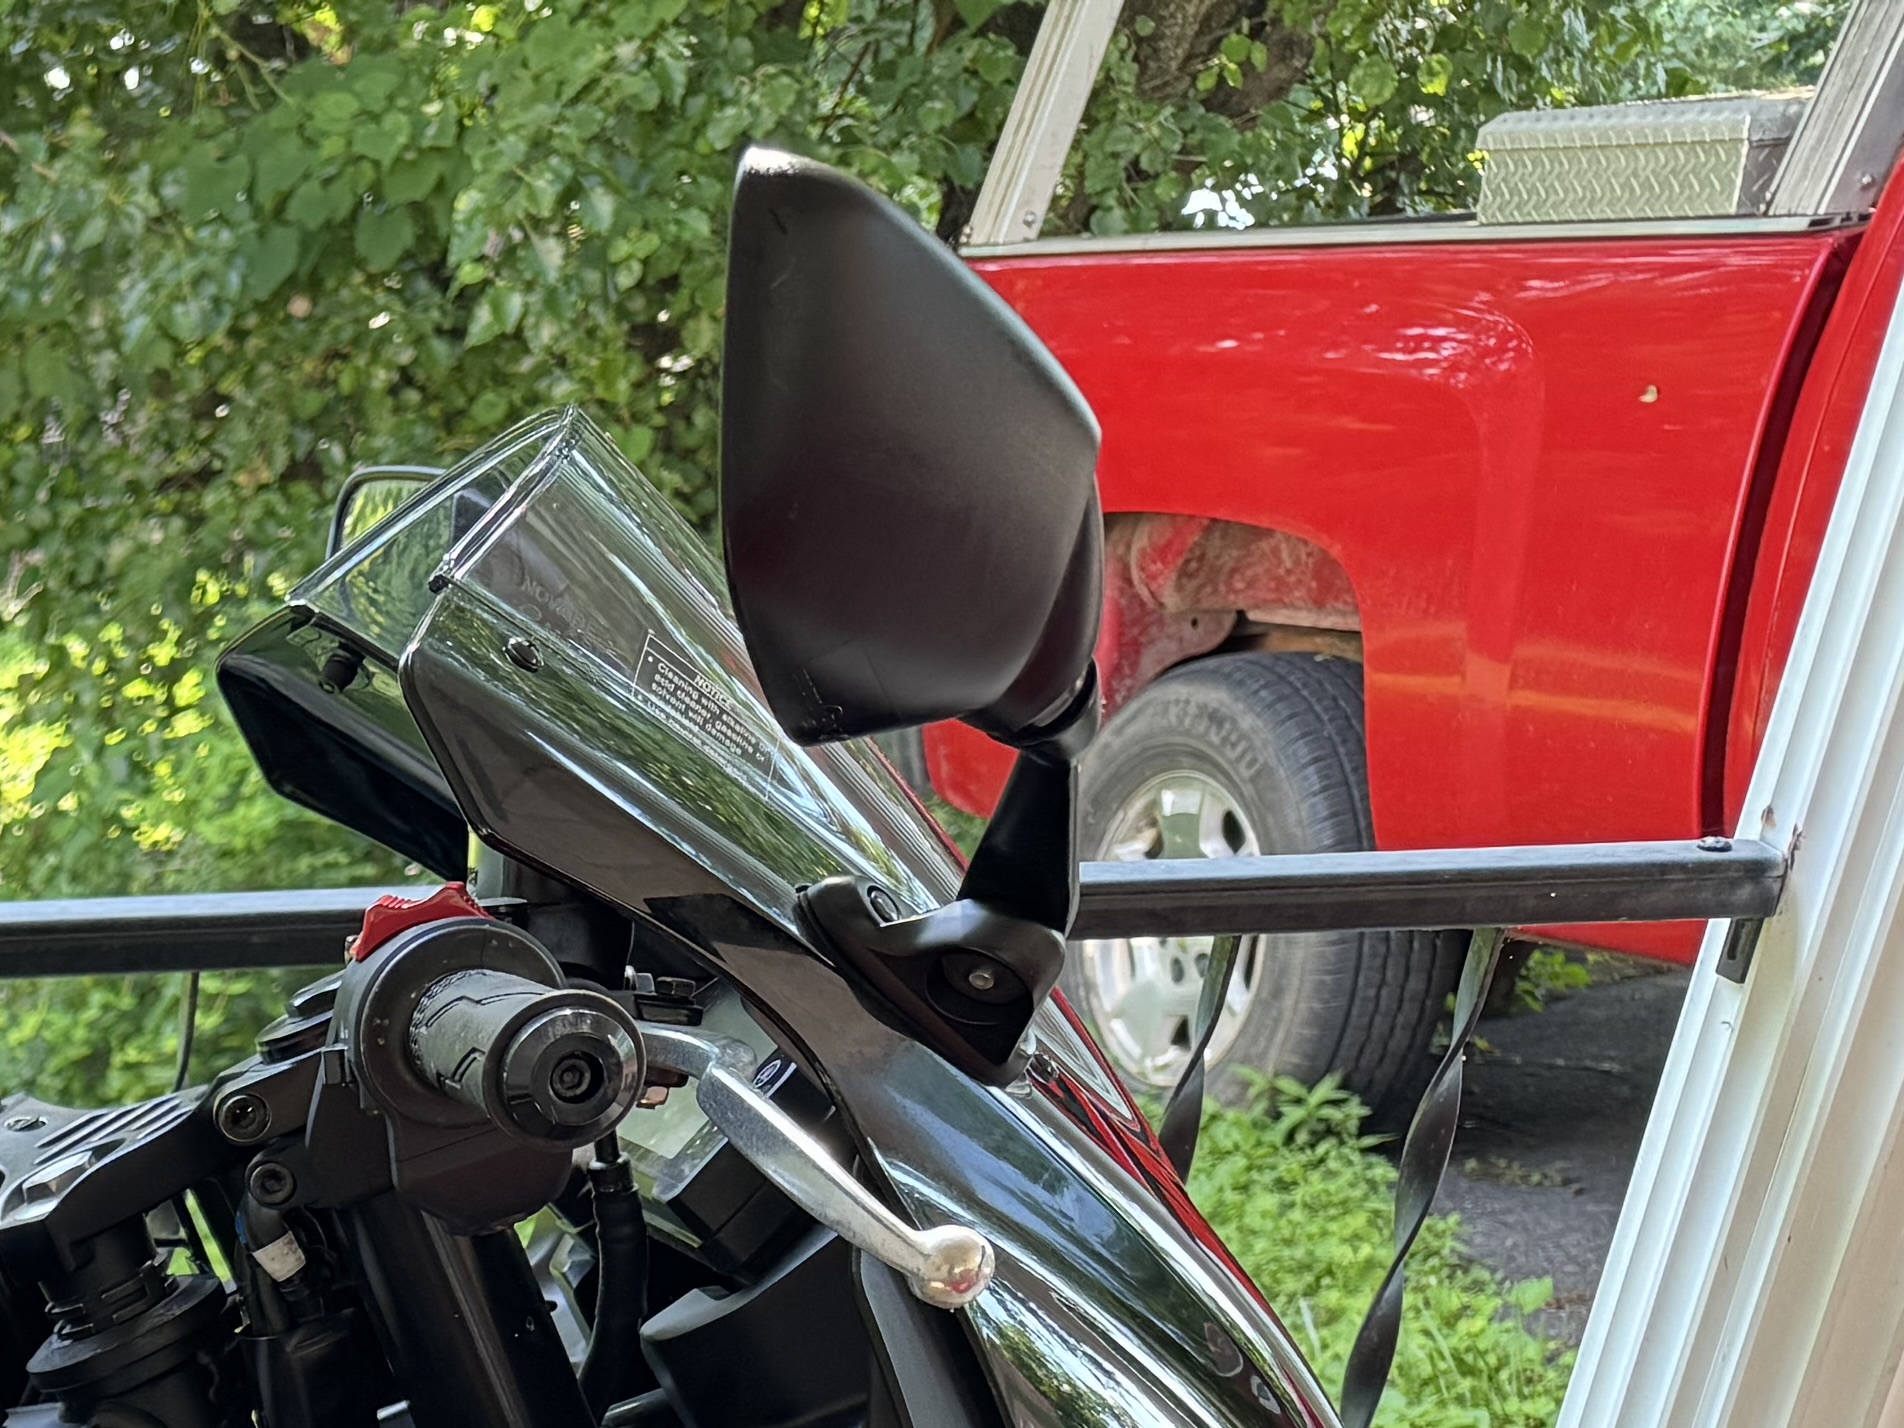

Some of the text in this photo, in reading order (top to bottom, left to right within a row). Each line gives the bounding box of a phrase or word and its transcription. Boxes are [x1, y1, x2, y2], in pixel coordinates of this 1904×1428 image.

[657, 662, 699, 700] Cleaning
[700, 693, 721, 716] with
[651, 682, 743, 756] solvent will damage
[714, 721, 754, 755] gasoline
